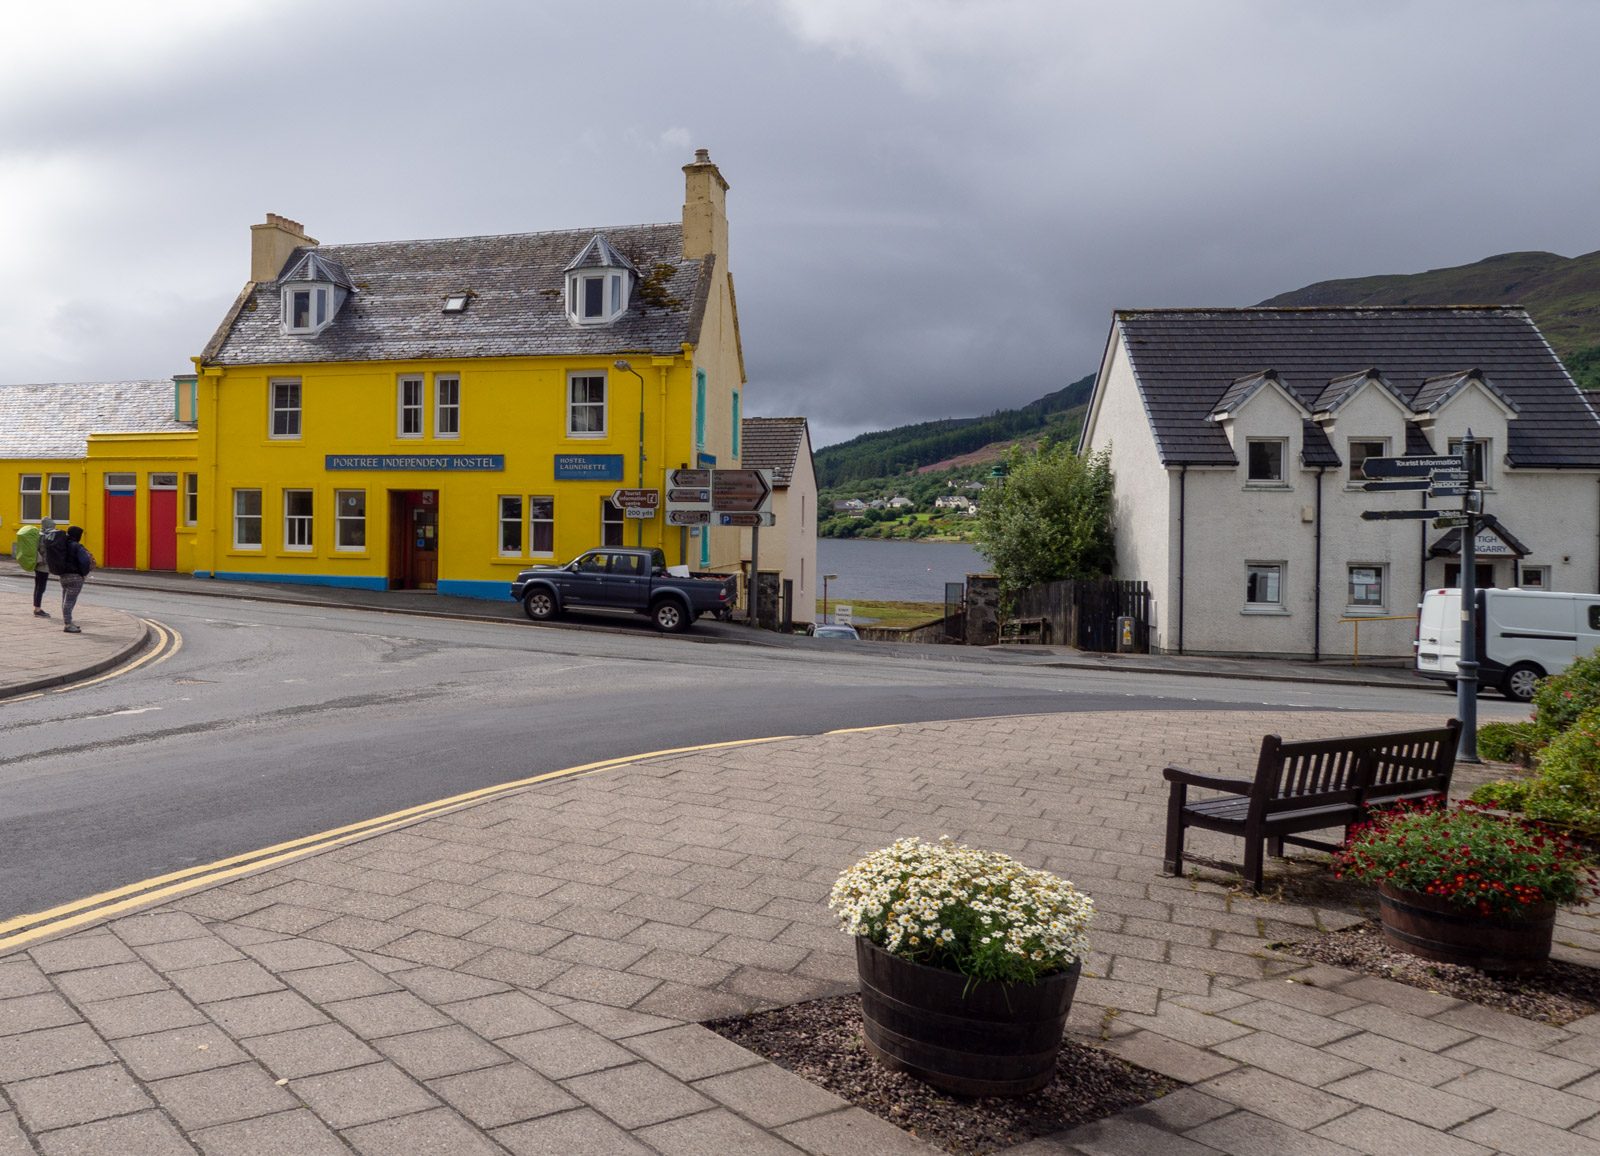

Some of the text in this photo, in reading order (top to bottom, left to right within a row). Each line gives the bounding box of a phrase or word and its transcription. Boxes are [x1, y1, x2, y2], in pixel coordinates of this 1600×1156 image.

[333, 457, 496, 468] PORTREE INDEPENDENT HOSTEL
[1477, 535, 1497, 543] TIGH
